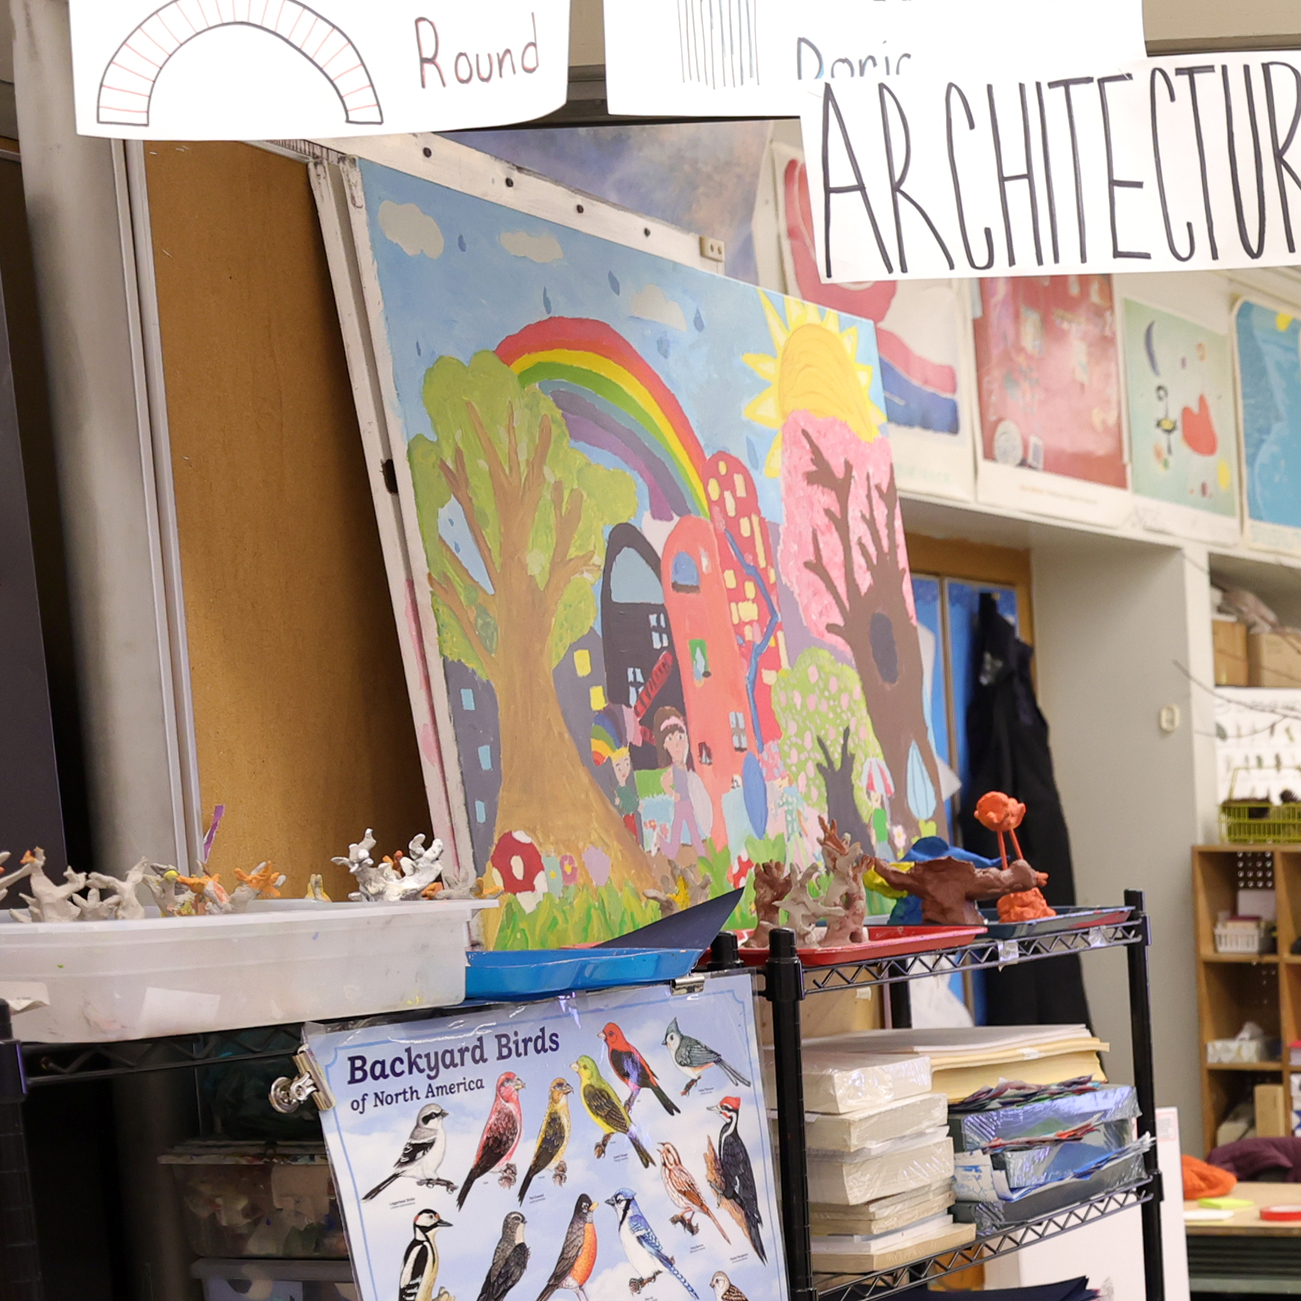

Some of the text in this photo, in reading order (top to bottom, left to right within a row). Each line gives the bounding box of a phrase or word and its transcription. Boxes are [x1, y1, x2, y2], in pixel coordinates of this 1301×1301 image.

[416, 12, 540, 88] Round
[347, 1026, 560, 1085] Backyard Birds
[351, 1077, 485, 1114] of North America
